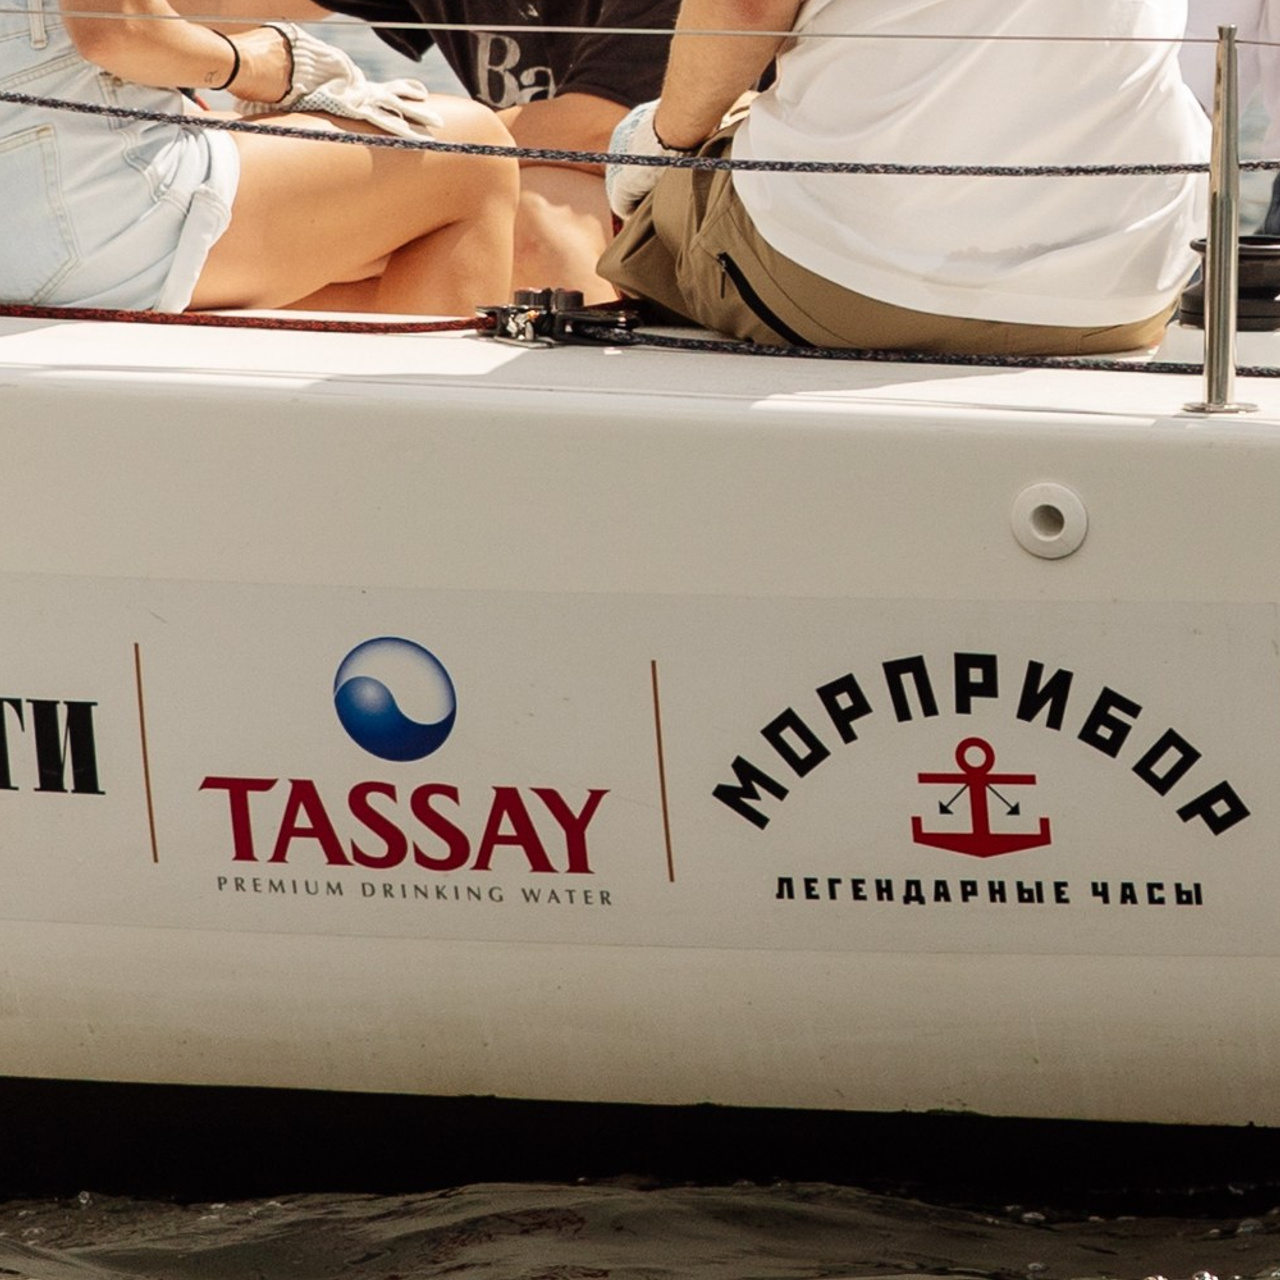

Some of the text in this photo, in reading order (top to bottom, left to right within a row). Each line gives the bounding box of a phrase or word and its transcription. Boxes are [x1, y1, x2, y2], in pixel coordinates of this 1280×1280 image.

[712, 652, 1251, 836] МОРПРИБОР
[198, 776, 611, 874] TASSAY
[217, 875, 613, 906] PREMIUM DRINKING WATER
[775, 877, 1203, 905] ЛЕГЕНДАРНЫЕ ЧАСЫ
